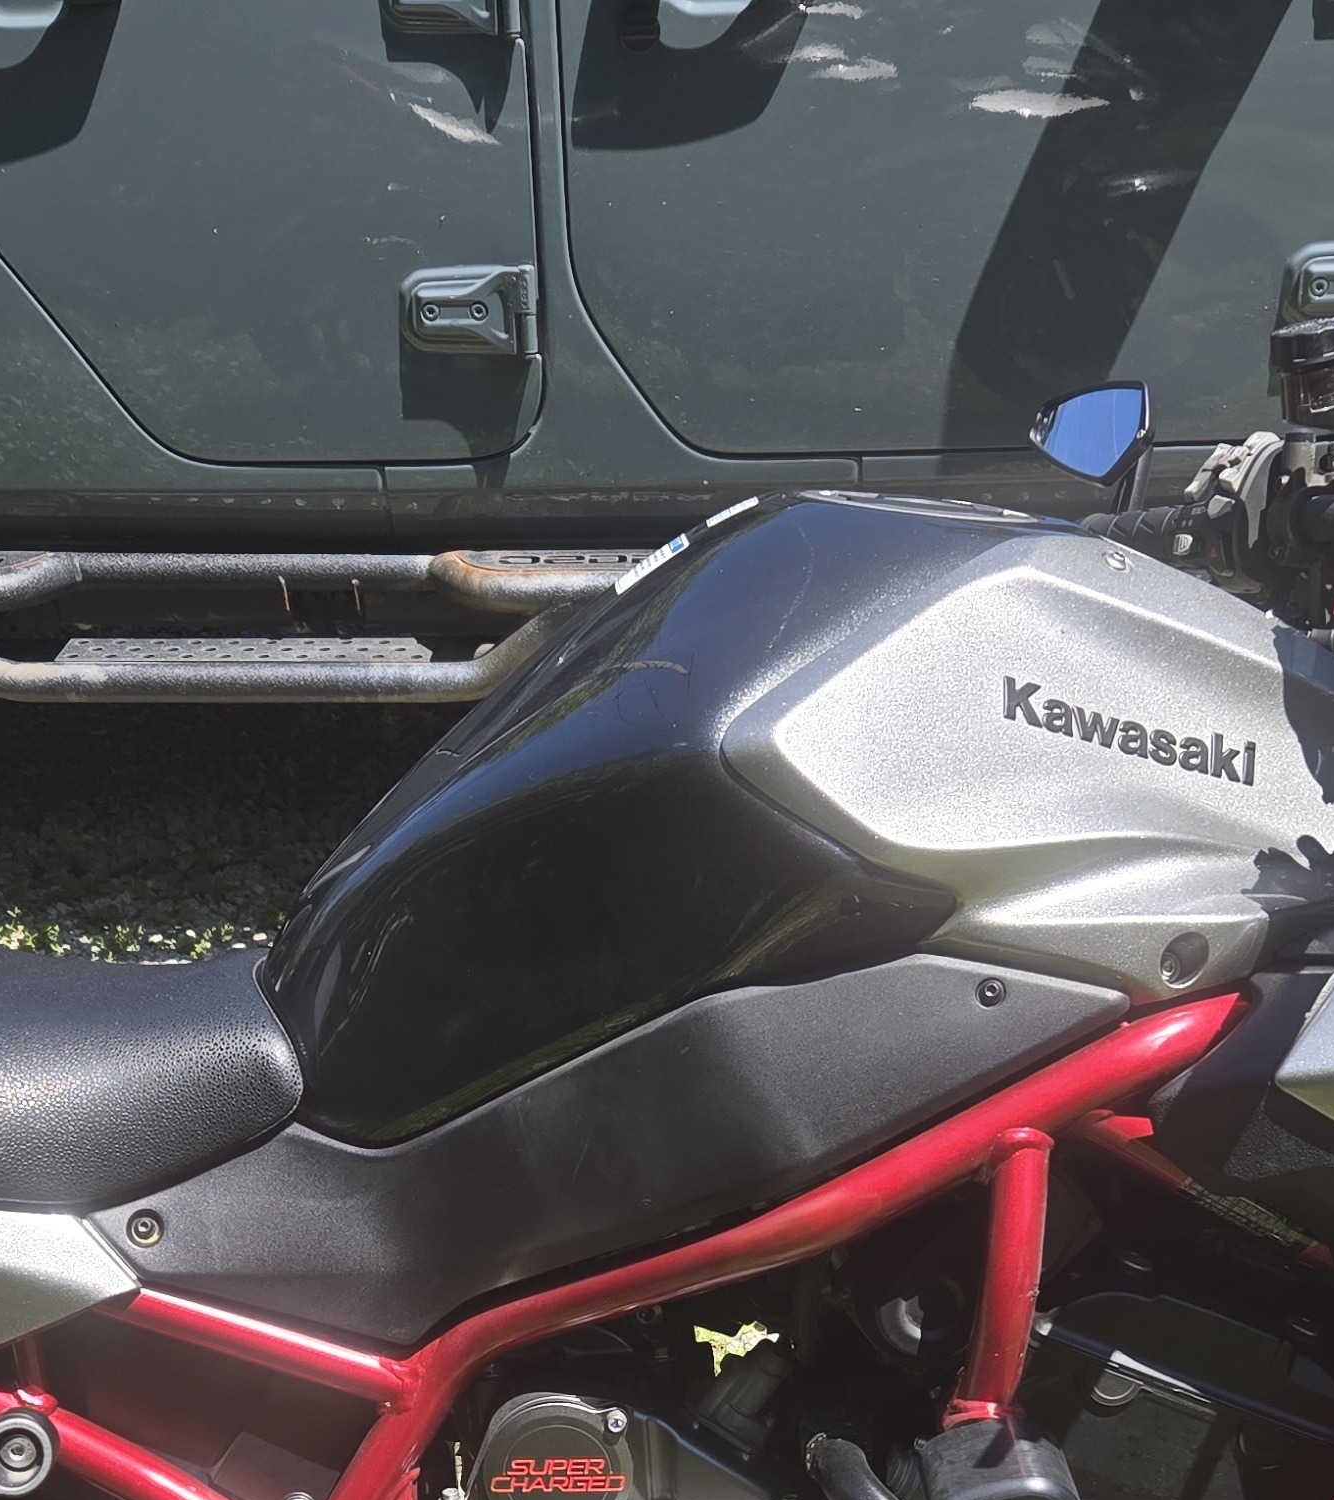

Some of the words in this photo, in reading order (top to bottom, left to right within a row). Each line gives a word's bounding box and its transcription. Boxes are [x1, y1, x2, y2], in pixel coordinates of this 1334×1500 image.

[1003, 675, 1257, 787] Kawasaki
[507, 1458, 606, 1476] SUPER
[491, 1474, 628, 1493] CHARGED
